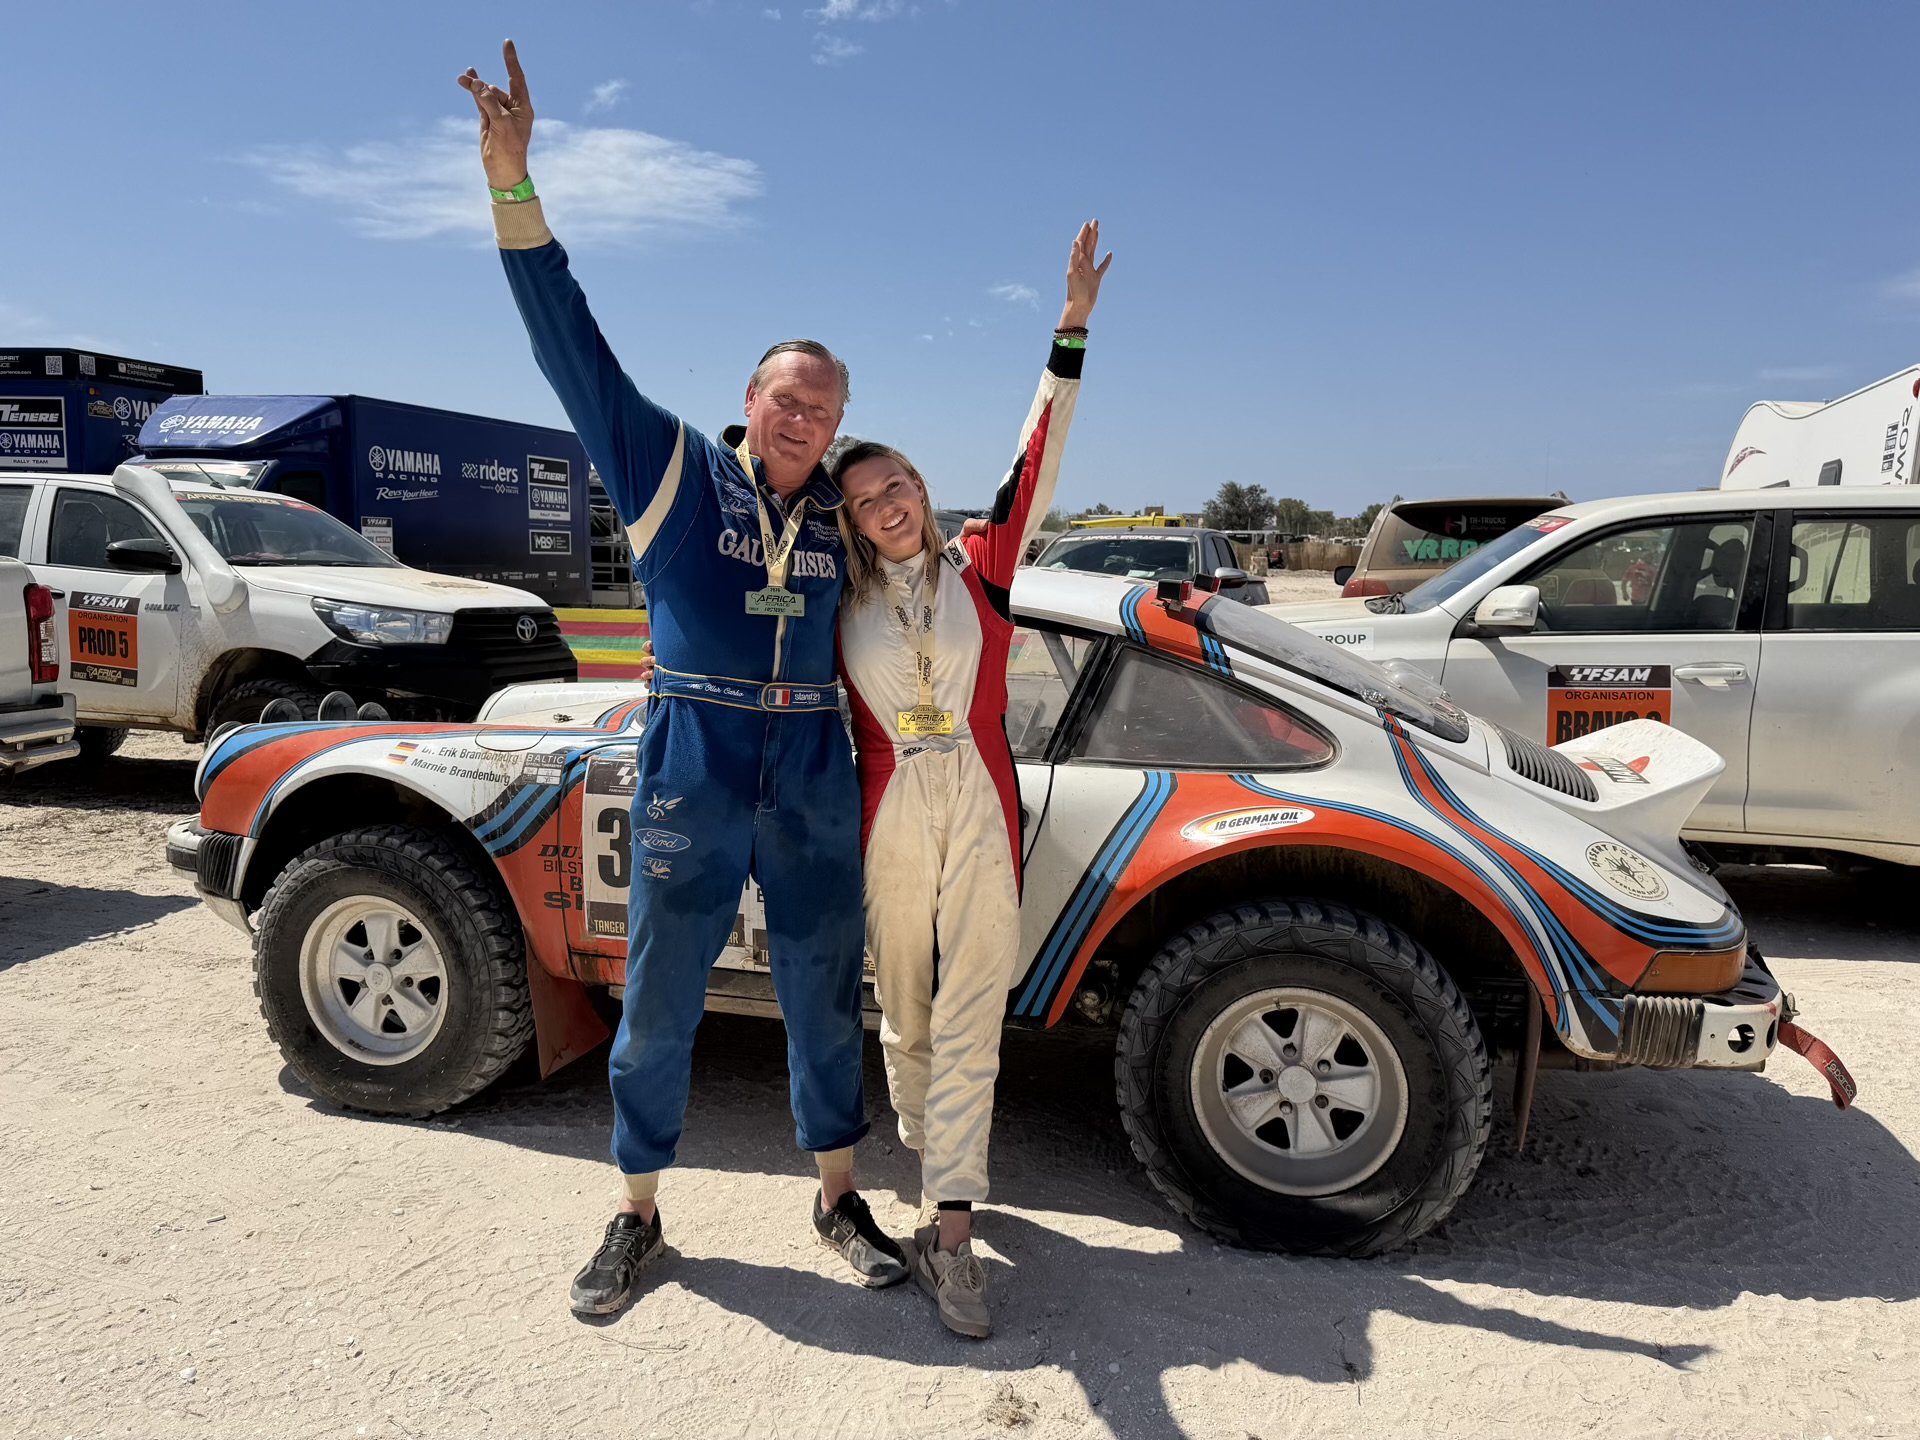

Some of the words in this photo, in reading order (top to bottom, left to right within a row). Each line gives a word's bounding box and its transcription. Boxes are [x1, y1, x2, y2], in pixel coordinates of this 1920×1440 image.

[182, 415, 264, 430] YAMAHA
[12, 433, 61, 449] YAMAHA
[385, 448, 442, 476] YAMAHA
[375, 472, 439, 483] RACING
[479, 459, 519, 483] riders
[540, 489, 568, 505] YAMAHA
[756, 594, 797, 604] AFRICA
[77, 612, 128, 623] ORGANISATION
[78, 626, 117, 657] PROD
[118, 631, 129, 659] 5
[1317, 634, 1367, 645] ROUP
[91, 667, 122, 678] AFRICA
[1564, 691, 1655, 701] ORGANISATION
[907, 714, 945, 722] AFRICA
[437, 747, 460, 758] Erik
[526, 753, 565, 765] BALTIC
[410, 758, 448, 774] Marnie
[448, 765, 512, 787] Brandenburg
[1228, 813, 1280, 828] GERMAN
[1280, 811, 1300, 821] OIL
[643, 830, 679, 849] Ford
[1588, 844, 1608, 868] DESERT
[1609, 876, 1646, 895] OVERLAND
[593, 918, 626, 935] TANGER
[1828, 1062, 1854, 1098] sparco
